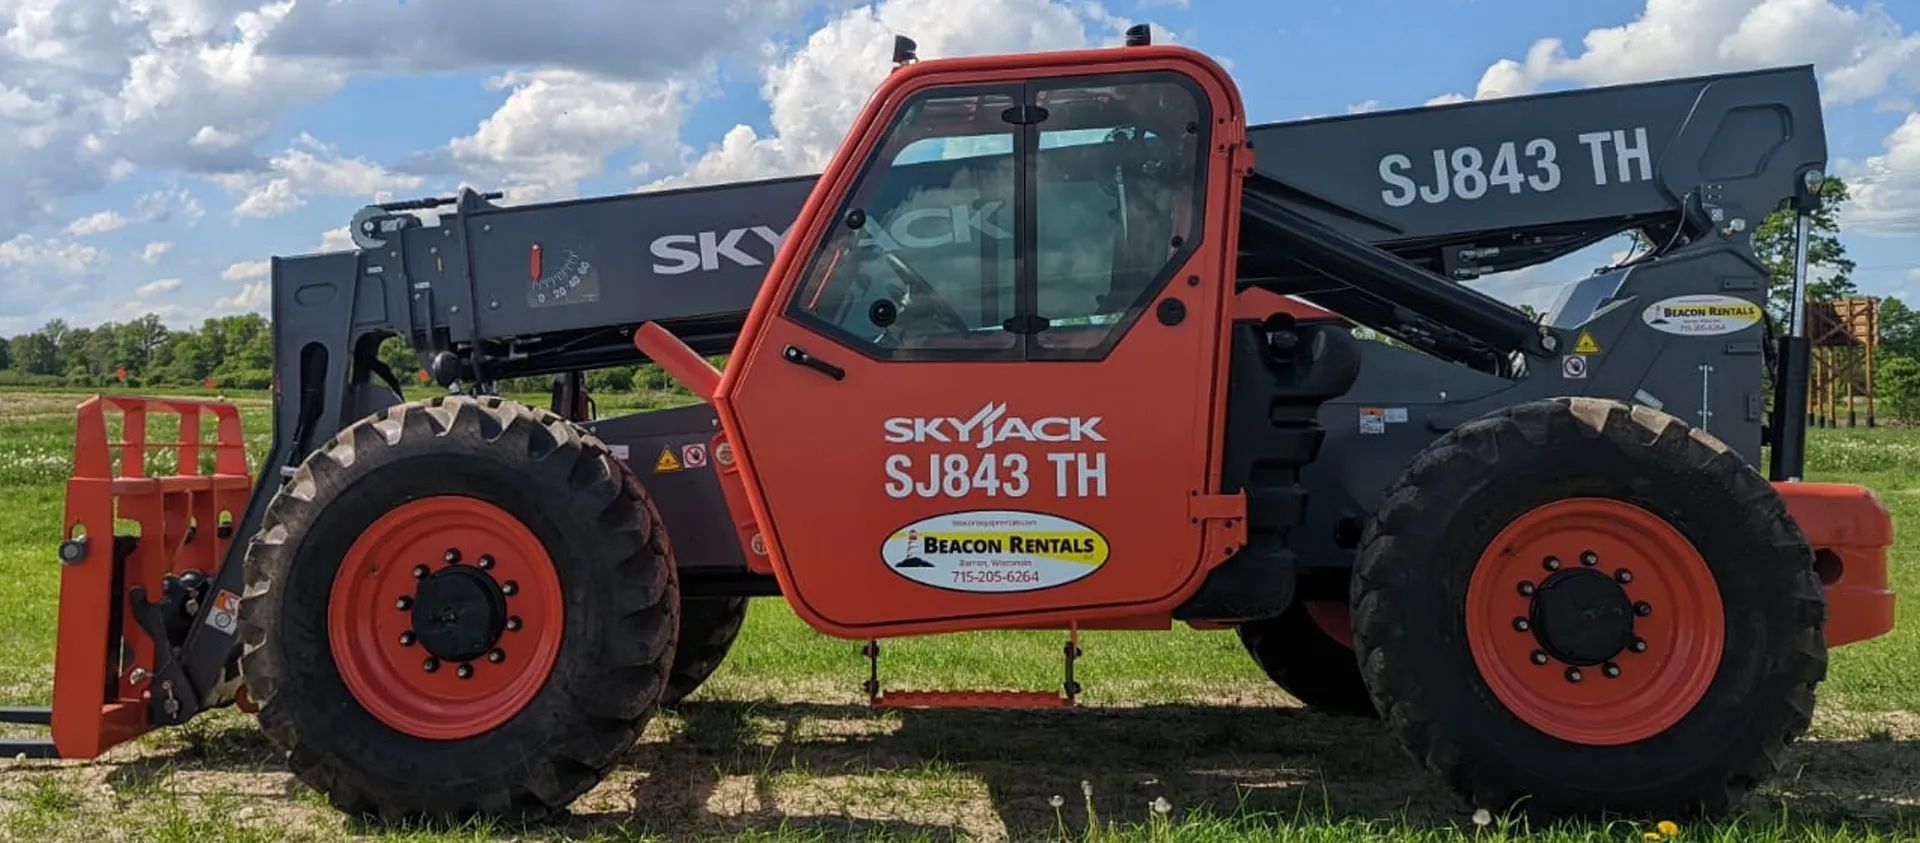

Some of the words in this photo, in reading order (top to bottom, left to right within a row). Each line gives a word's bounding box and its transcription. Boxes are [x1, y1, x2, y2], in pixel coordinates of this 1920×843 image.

[1379, 138, 1562, 207] SJ843
[1578, 127, 1653, 186] TH
[1663, 307, 1706, 318] BEACON
[1709, 305, 1754, 316] RENTALS
[884, 401, 1107, 449] SKYJACK
[885, 453, 1030, 498] SJ843
[1047, 452, 1107, 498] TH
[924, 536, 1001, 554] BEACON
[1010, 535, 1094, 554] RENTALS
[952, 571, 1039, 583] 715-205-6264
